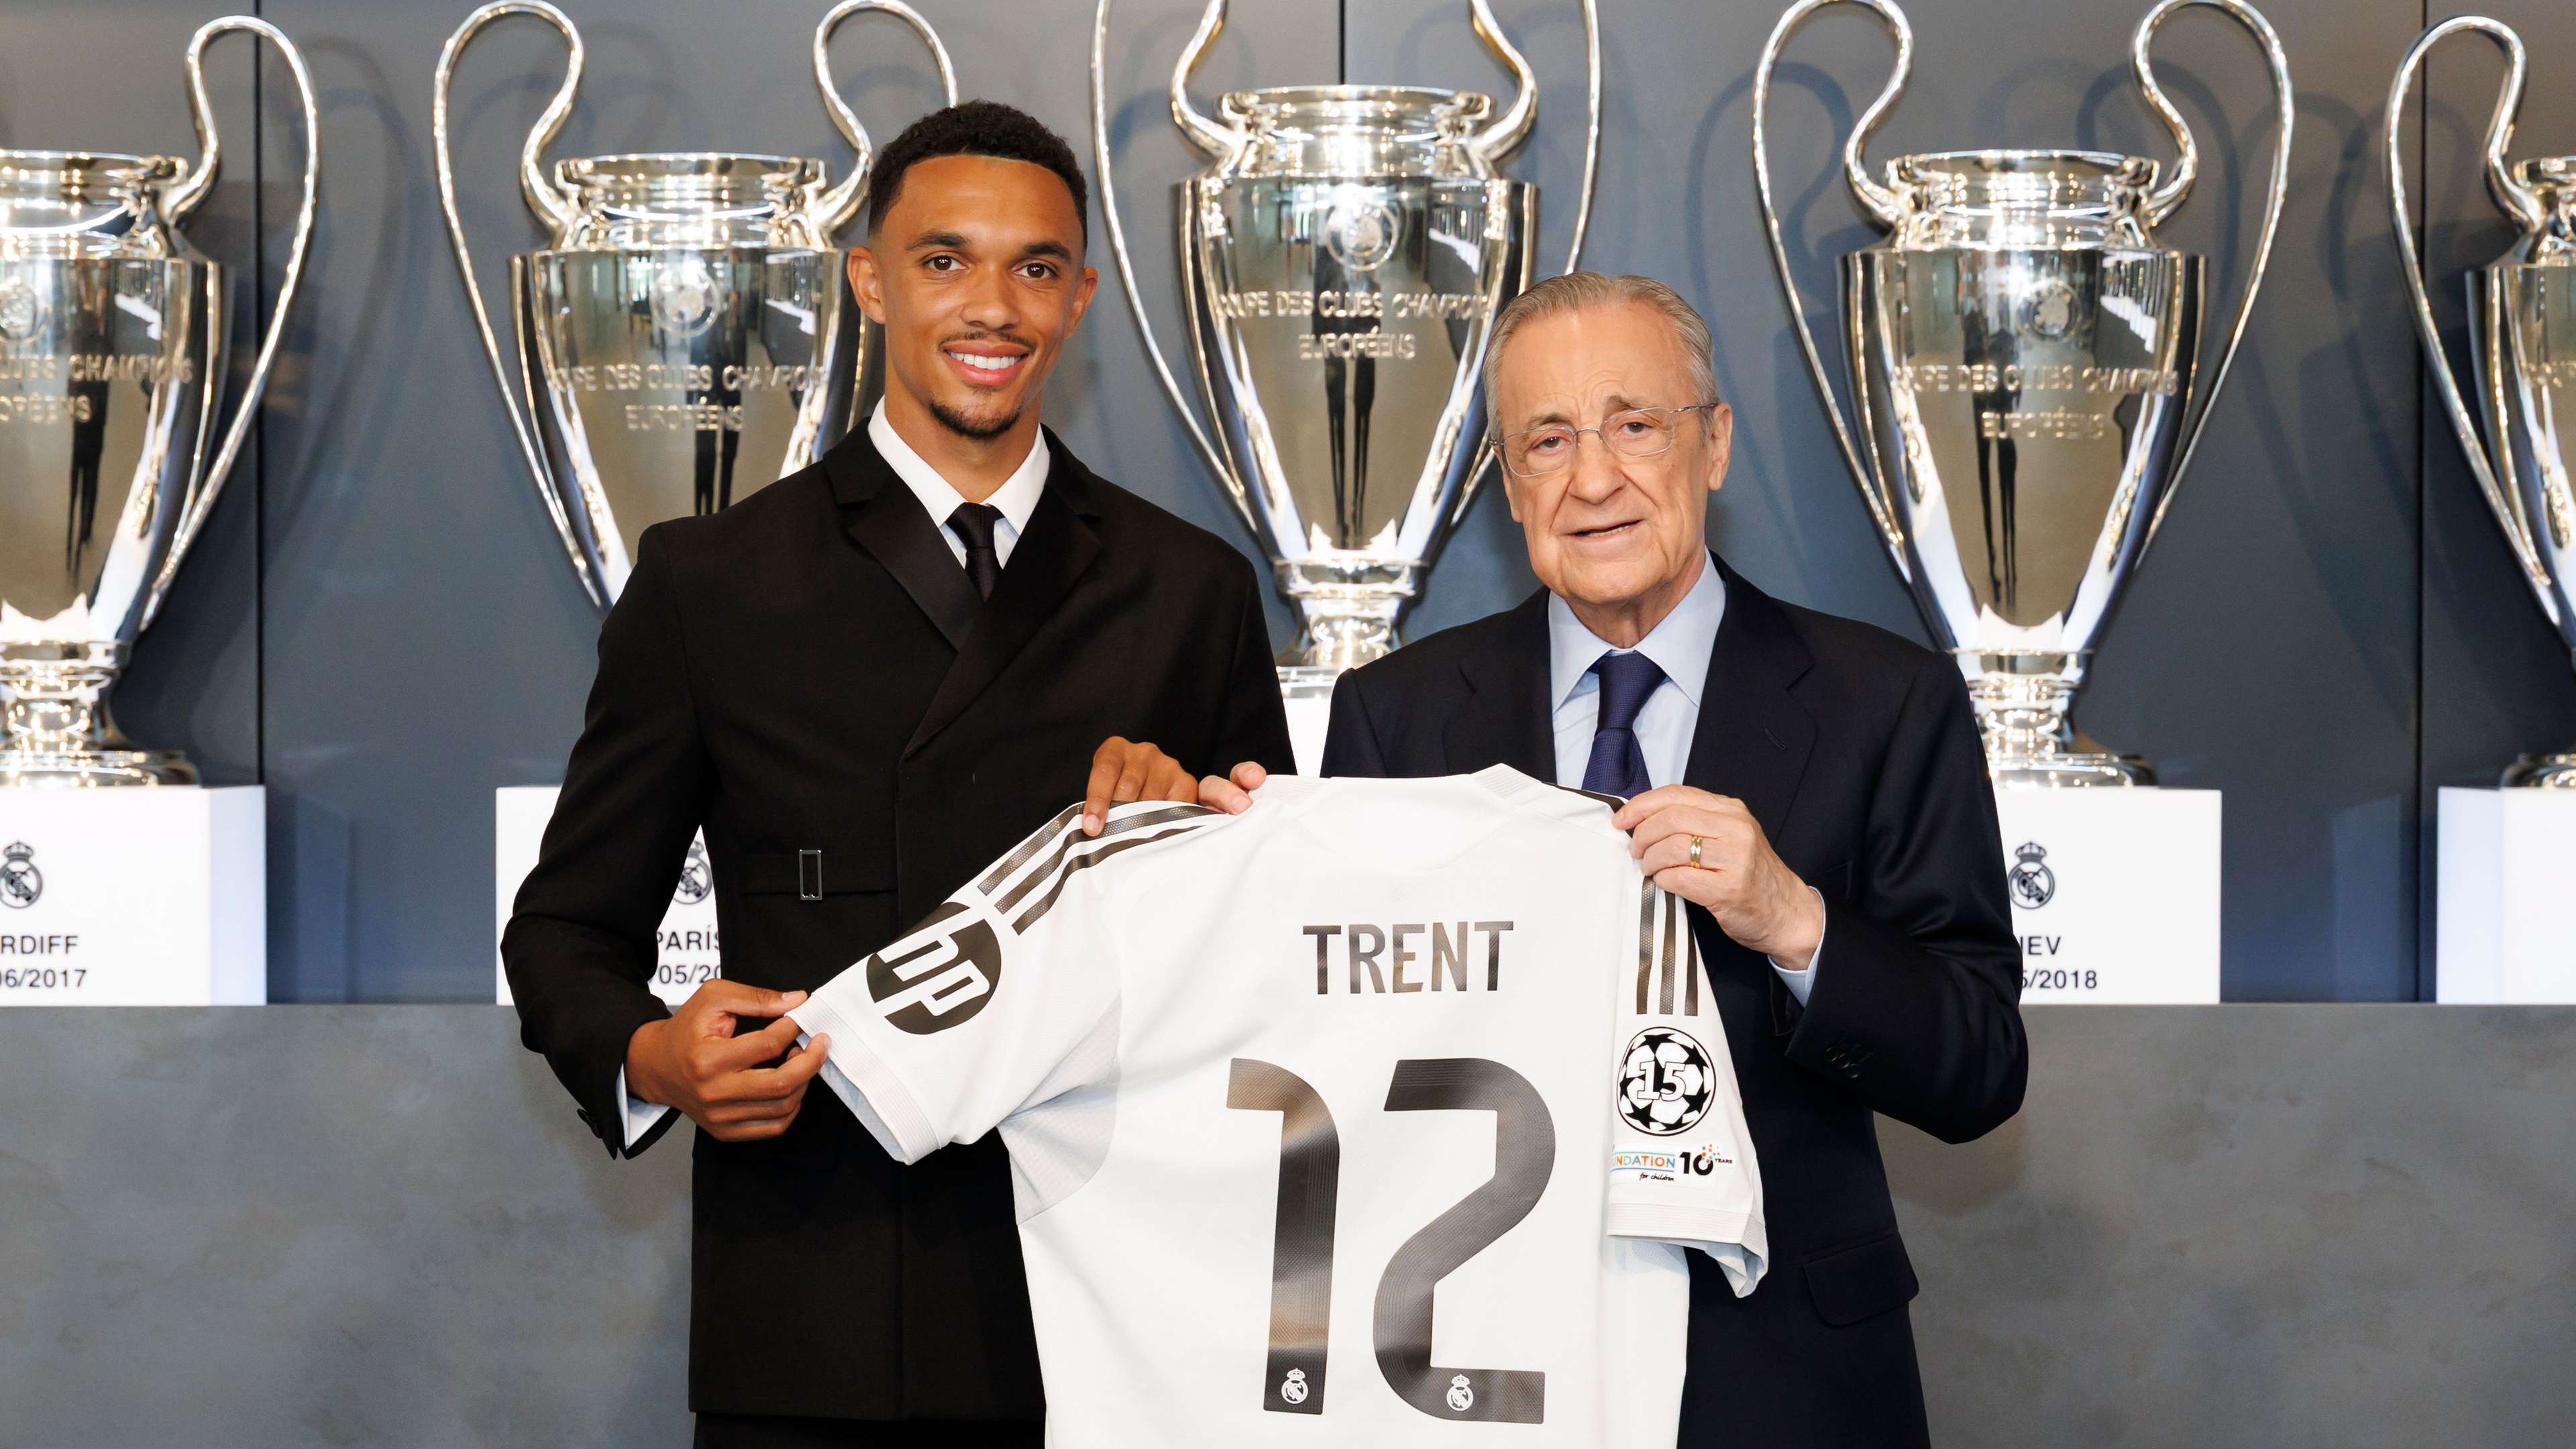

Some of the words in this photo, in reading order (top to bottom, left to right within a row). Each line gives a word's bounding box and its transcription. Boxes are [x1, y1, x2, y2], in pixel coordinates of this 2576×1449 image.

[1276, 290, 1313, 317] DES
[1319, 290, 1383, 319] CLUBS
[604, 364, 641, 390] DES
[1956, 364, 1998, 392] DES
[1, 935, 78, 955] RDIFF
[1303, 921, 1514, 995] TRENT
[872, 906, 992, 1020] hp
[0, 969, 87, 988] 6/2017
[1637, 1061, 1686, 1102] 15
[1640, 1172, 1649, 1181] for
[1650, 1173, 1674, 1181] children
[1679, 1152, 1713, 1175] 10
[1226, 1058, 1556, 1424] 12
